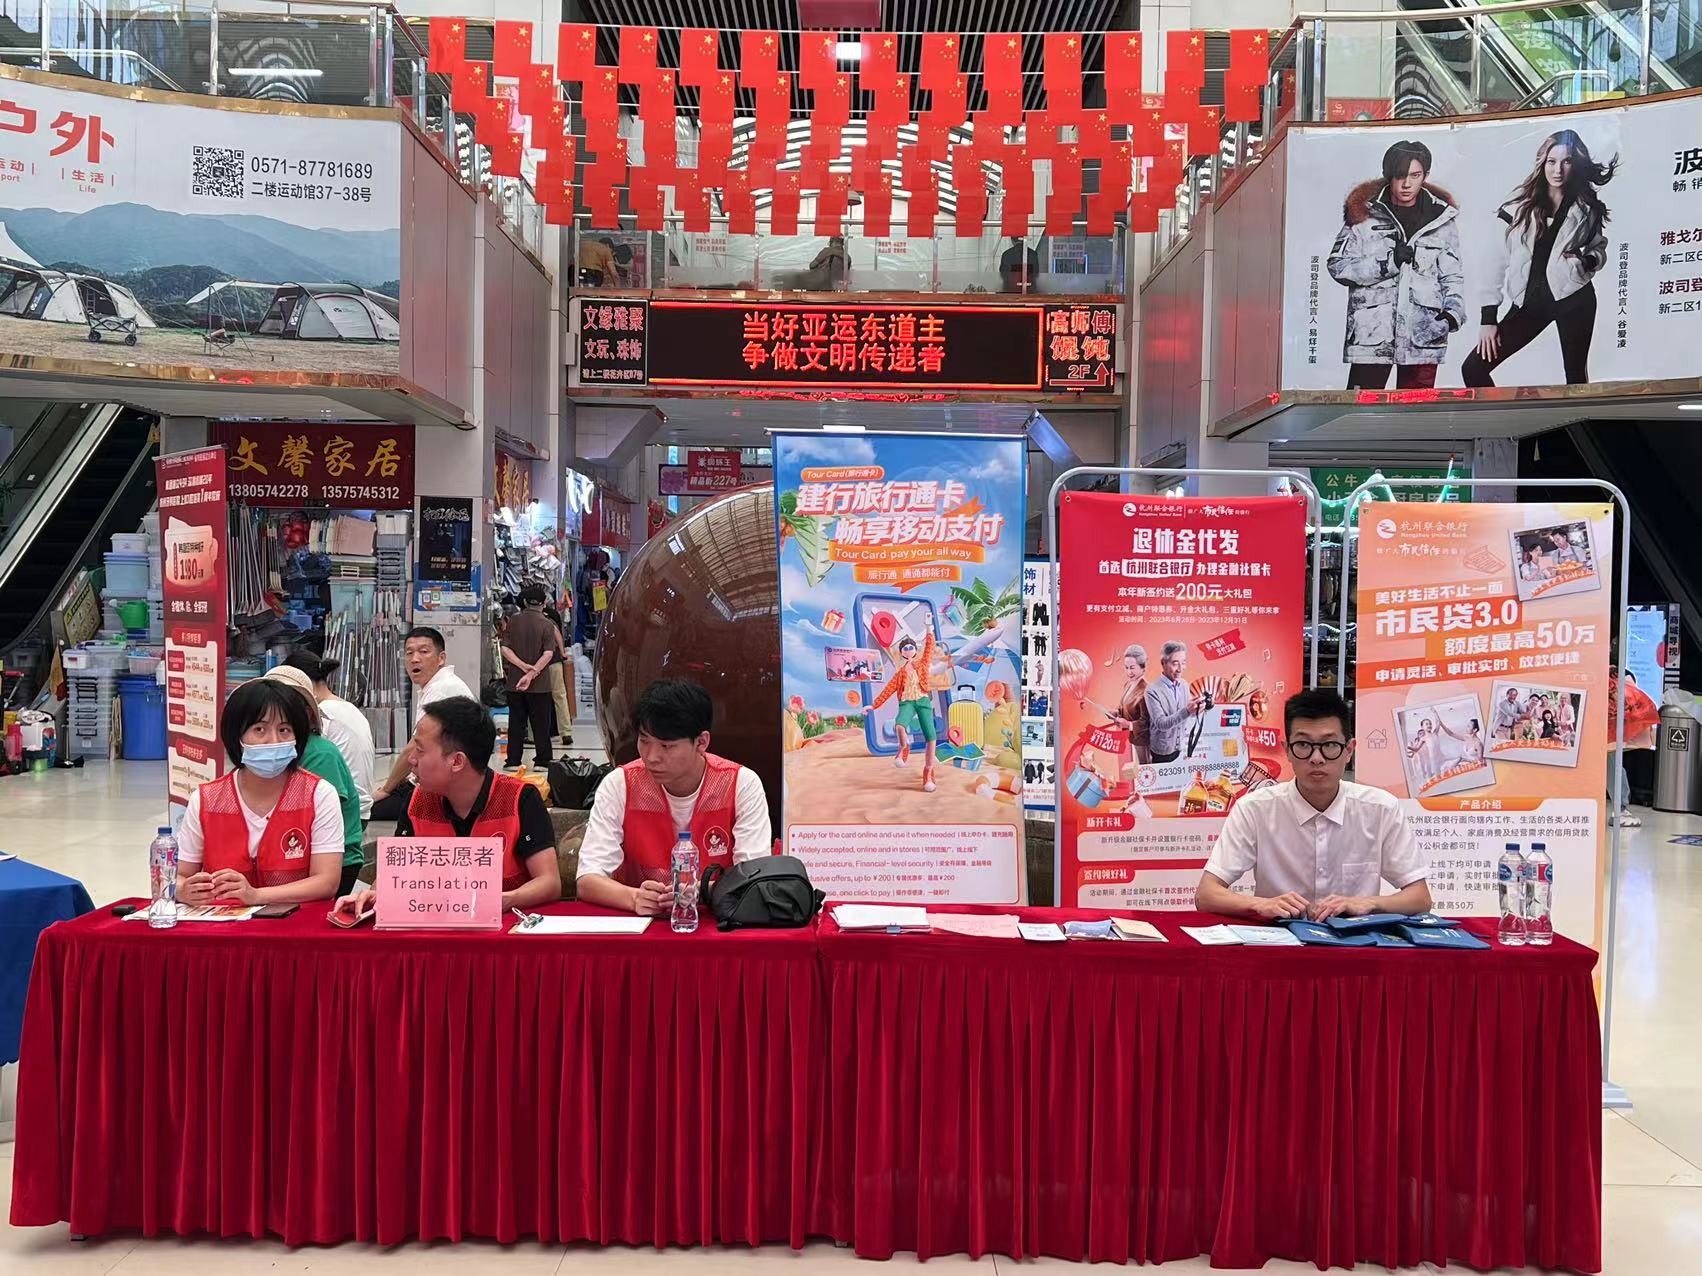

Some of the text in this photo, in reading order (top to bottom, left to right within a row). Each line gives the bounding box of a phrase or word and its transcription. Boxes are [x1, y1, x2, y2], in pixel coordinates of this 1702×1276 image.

[72, 169, 104, 183] 生活
[251, 156, 373, 179] 0571-87781689
[79, 184, 97, 194] Life
[251, 181, 372, 203] 二楼运动馆37-38号
[742, 311, 946, 343] 当好亚运东道主
[1050, 310, 1111, 334] 高师傅
[1049, 335, 1111, 361] 馄饨
[742, 342, 946, 373] 争做文明传递者
[1068, 364, 1091, 379] 2F
[228, 434, 401, 478] 文馨家居
[807, 470, 824, 479] Tour
[229, 483, 309, 498] 13805742278
[321, 484, 400, 500] 13575745312
[796, 480, 966, 515] 建行旅行通卡
[835, 513, 1004, 545] 畅享移动支付
[1132, 527, 1240, 555] 退休金代发
[836, 546, 971, 561] Tour Card pay your all way
[1376, 580, 1503, 604] 美好生活不止一面
[1375, 599, 1519, 637] 市民贷3.0
[1444, 620, 1596, 657] 额度最高50万
[1375, 652, 1580, 681] 申请灵活、审批实时、放款便捷
[1258, 729, 1277, 747] ¥50
[1158, 766, 1186, 777] 623091
[1459, 799, 1502, 810] 产品介绍
[798, 831, 818, 840] Apply
[818, 831, 828, 839] for
[1414, 828, 1590, 837] 效满足个人、家庭消费及经营需求的信用贷款
[385, 845, 495, 868] 翻译志愿者
[798, 846, 820, 854] Widely
[822, 846, 855, 854] accepted,
[829, 861, 854, 869] secure,
[908, 860, 934, 869] security
[391, 876, 488, 890] Translation
[832, 874, 853, 883] offers,
[878, 890, 890, 898] pay
[408, 899, 470, 913] Service
